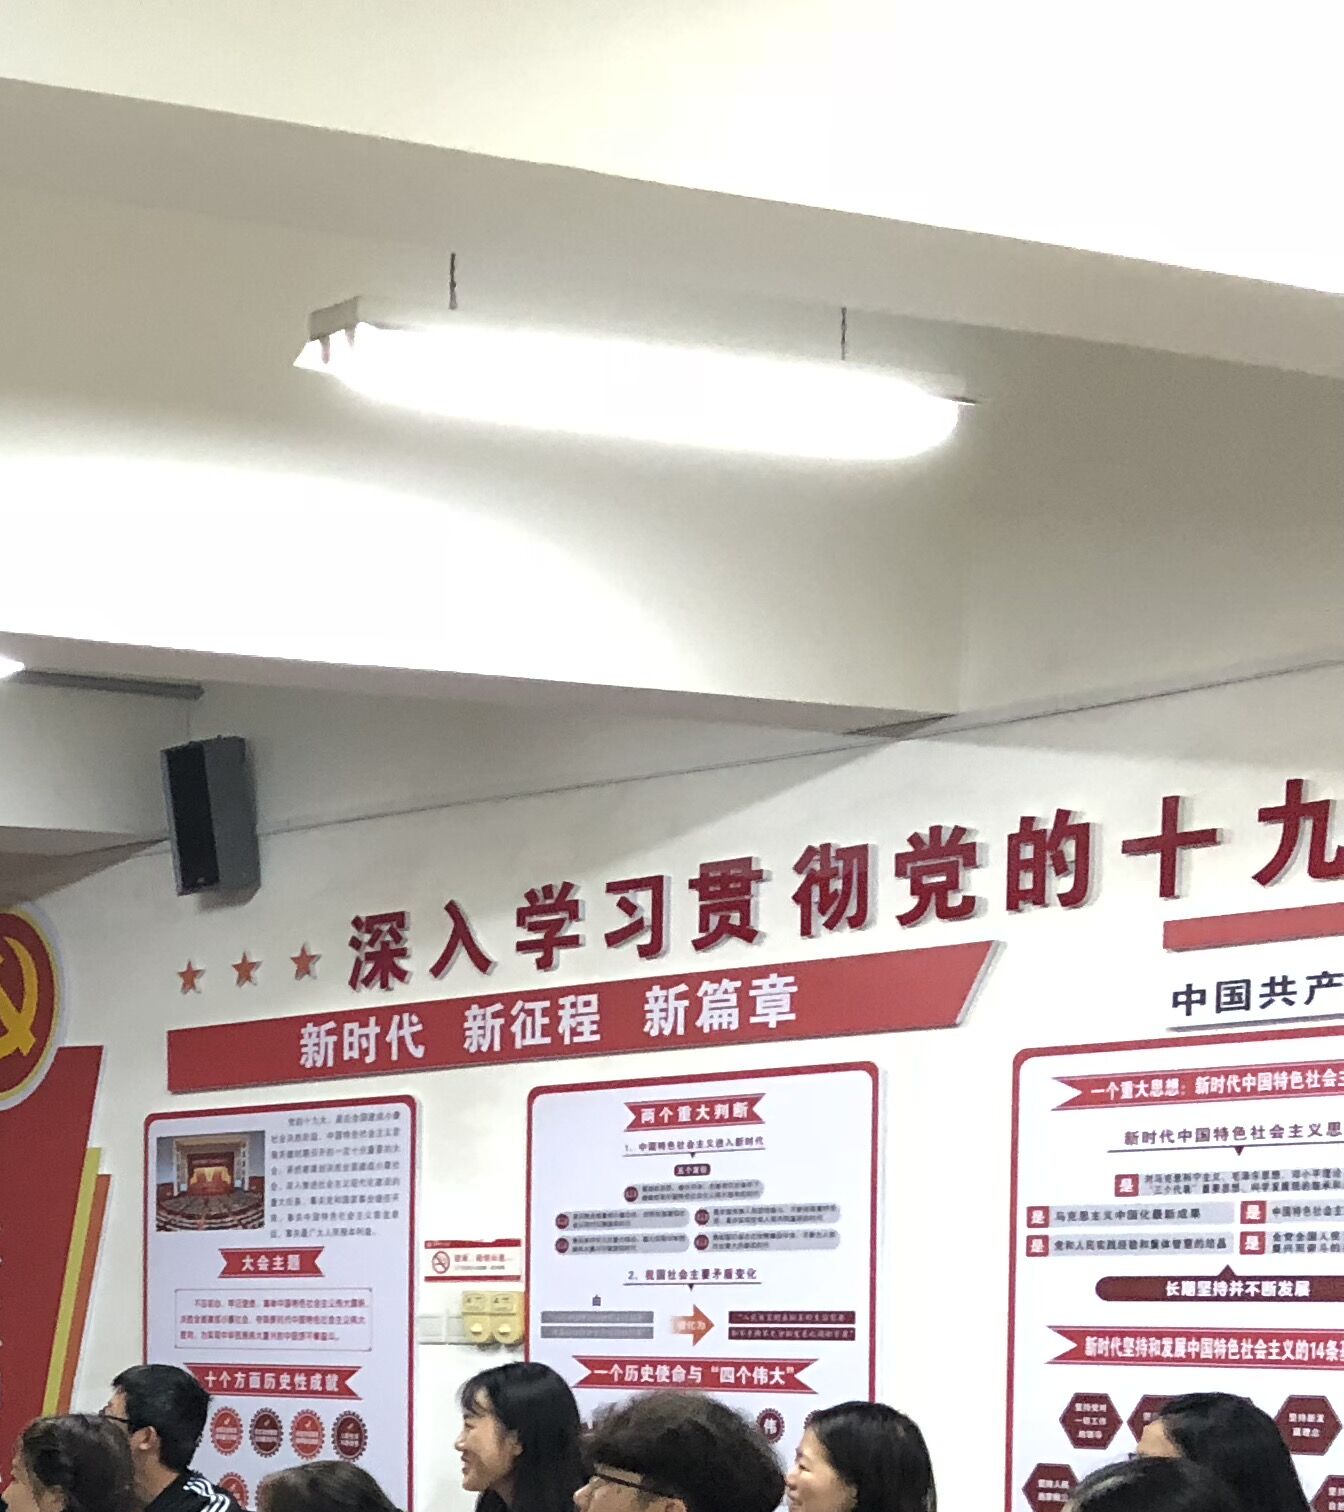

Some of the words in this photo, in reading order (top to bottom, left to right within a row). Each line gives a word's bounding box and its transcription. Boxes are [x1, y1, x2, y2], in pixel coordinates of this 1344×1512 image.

[347, 779, 1344, 991] 深入学习贯彻党的十九
[1172, 971, 1344, 1016] 中国共产
[299, 1014, 425, 1069] 新时代
[463, 994, 601, 1053] 新征程
[643, 973, 797, 1037] 新篇章
[640, 1101, 749, 1124] 两个重大判断
[1124, 1121, 1343, 1146] 新时代中国特色社会主义思
[1118, 1177, 1134, 1193] 是
[1030, 1209, 1046, 1225] 是
[1245, 1204, 1261, 1220] 是
[1030, 1237, 1046, 1253] 是
[1244, 1235, 1261, 1251] 是
[241, 1254, 301, 1272] 大会主题
[1165, 1280, 1311, 1297] 长期坚持并不断发展
[204, 1371, 340, 1392] 十个方面历史性成就
[763, 1417, 778, 1435] 伟
